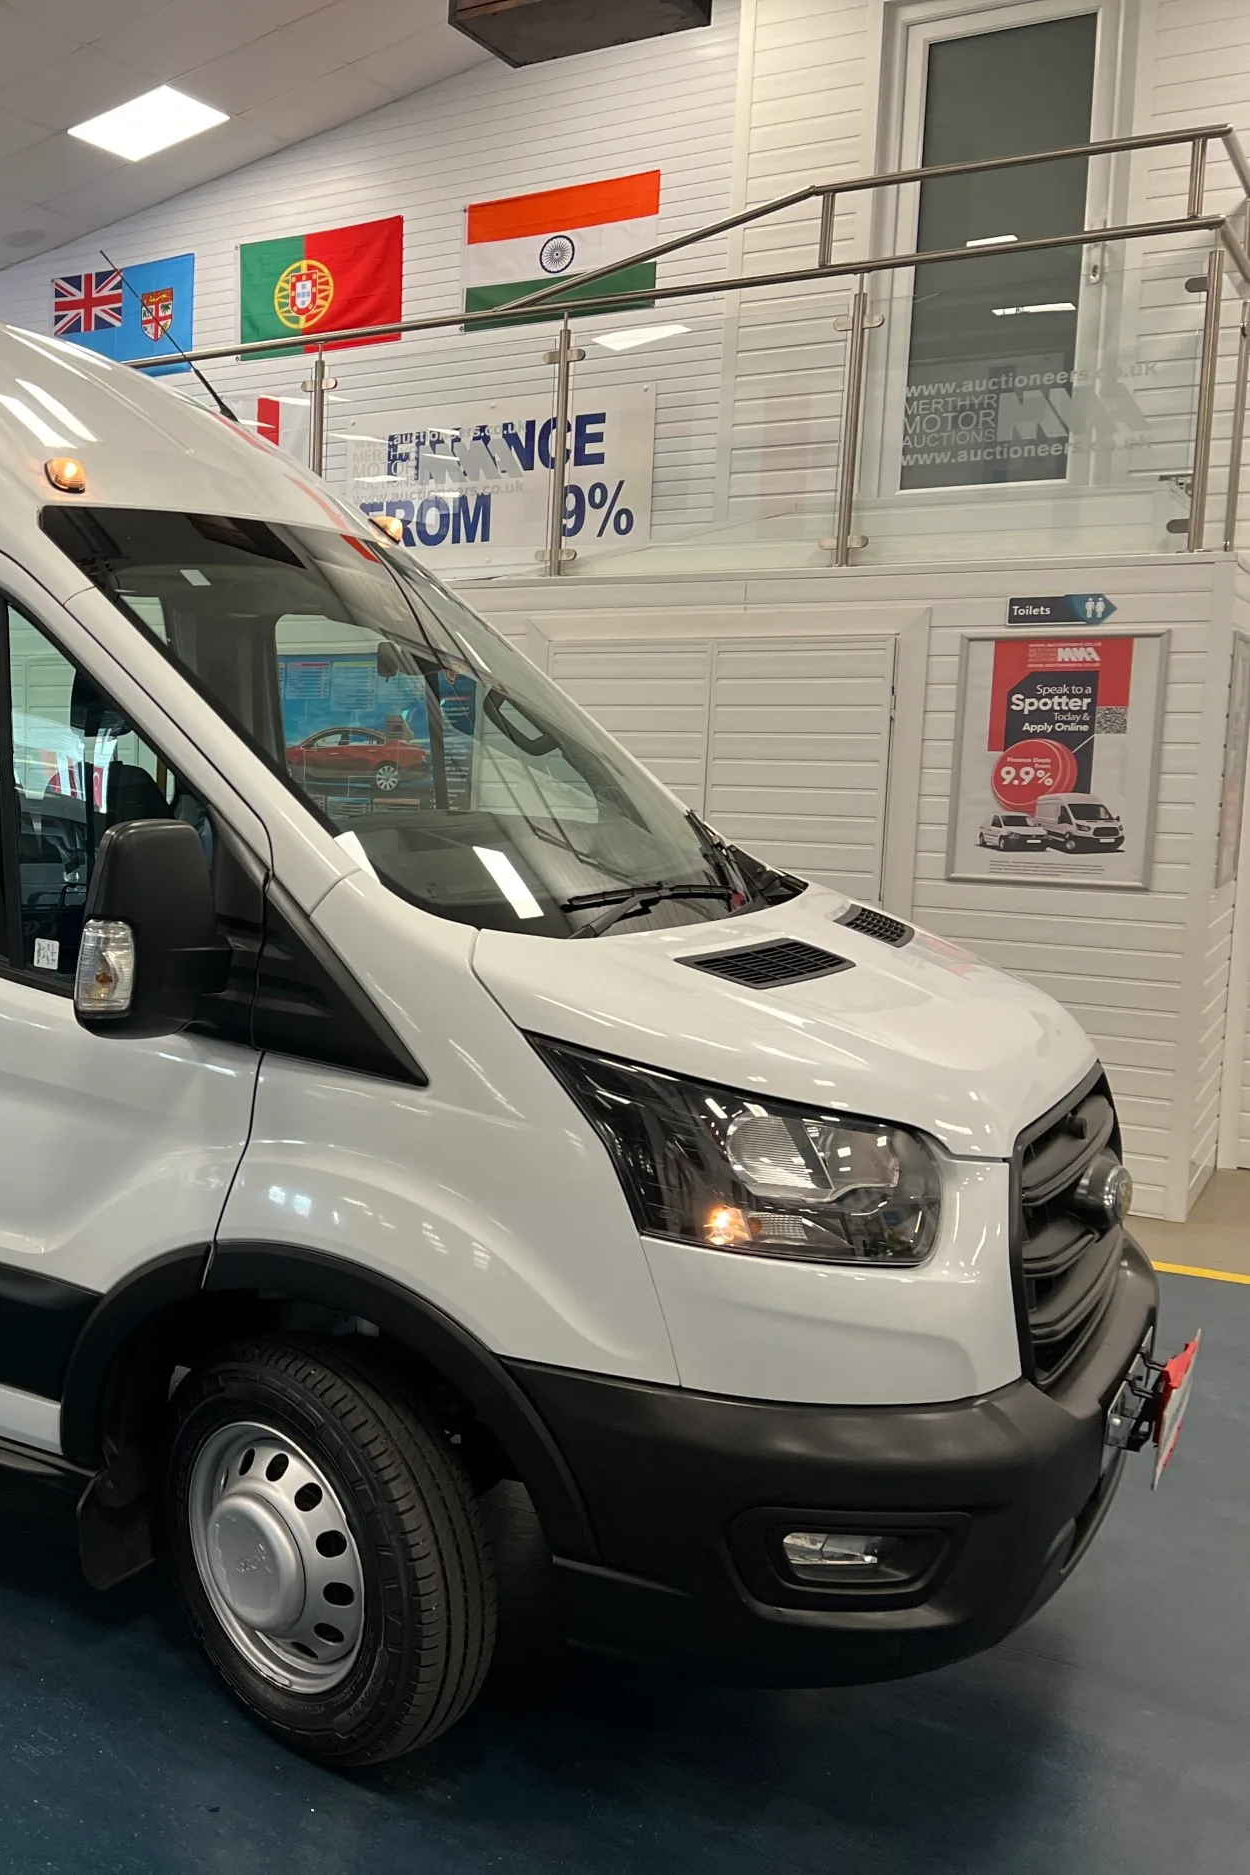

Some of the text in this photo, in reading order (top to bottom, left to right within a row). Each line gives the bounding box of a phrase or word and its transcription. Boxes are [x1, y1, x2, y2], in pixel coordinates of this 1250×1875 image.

[904, 394, 998, 416] MERTHYR
[902, 409, 996, 435] MOTOR
[901, 428, 996, 450] AUCTIONS
[1012, 605, 1051, 616] Toilets
[1057, 647, 1102, 662] MMA
[1036, 684, 1092, 696] Speak to a
[1010, 694, 1092, 715] Spotter
[1053, 712, 1091, 723] Today &
[1022, 722, 1090, 733] Apply Online
[1000, 766, 1054, 786] 9.9%
